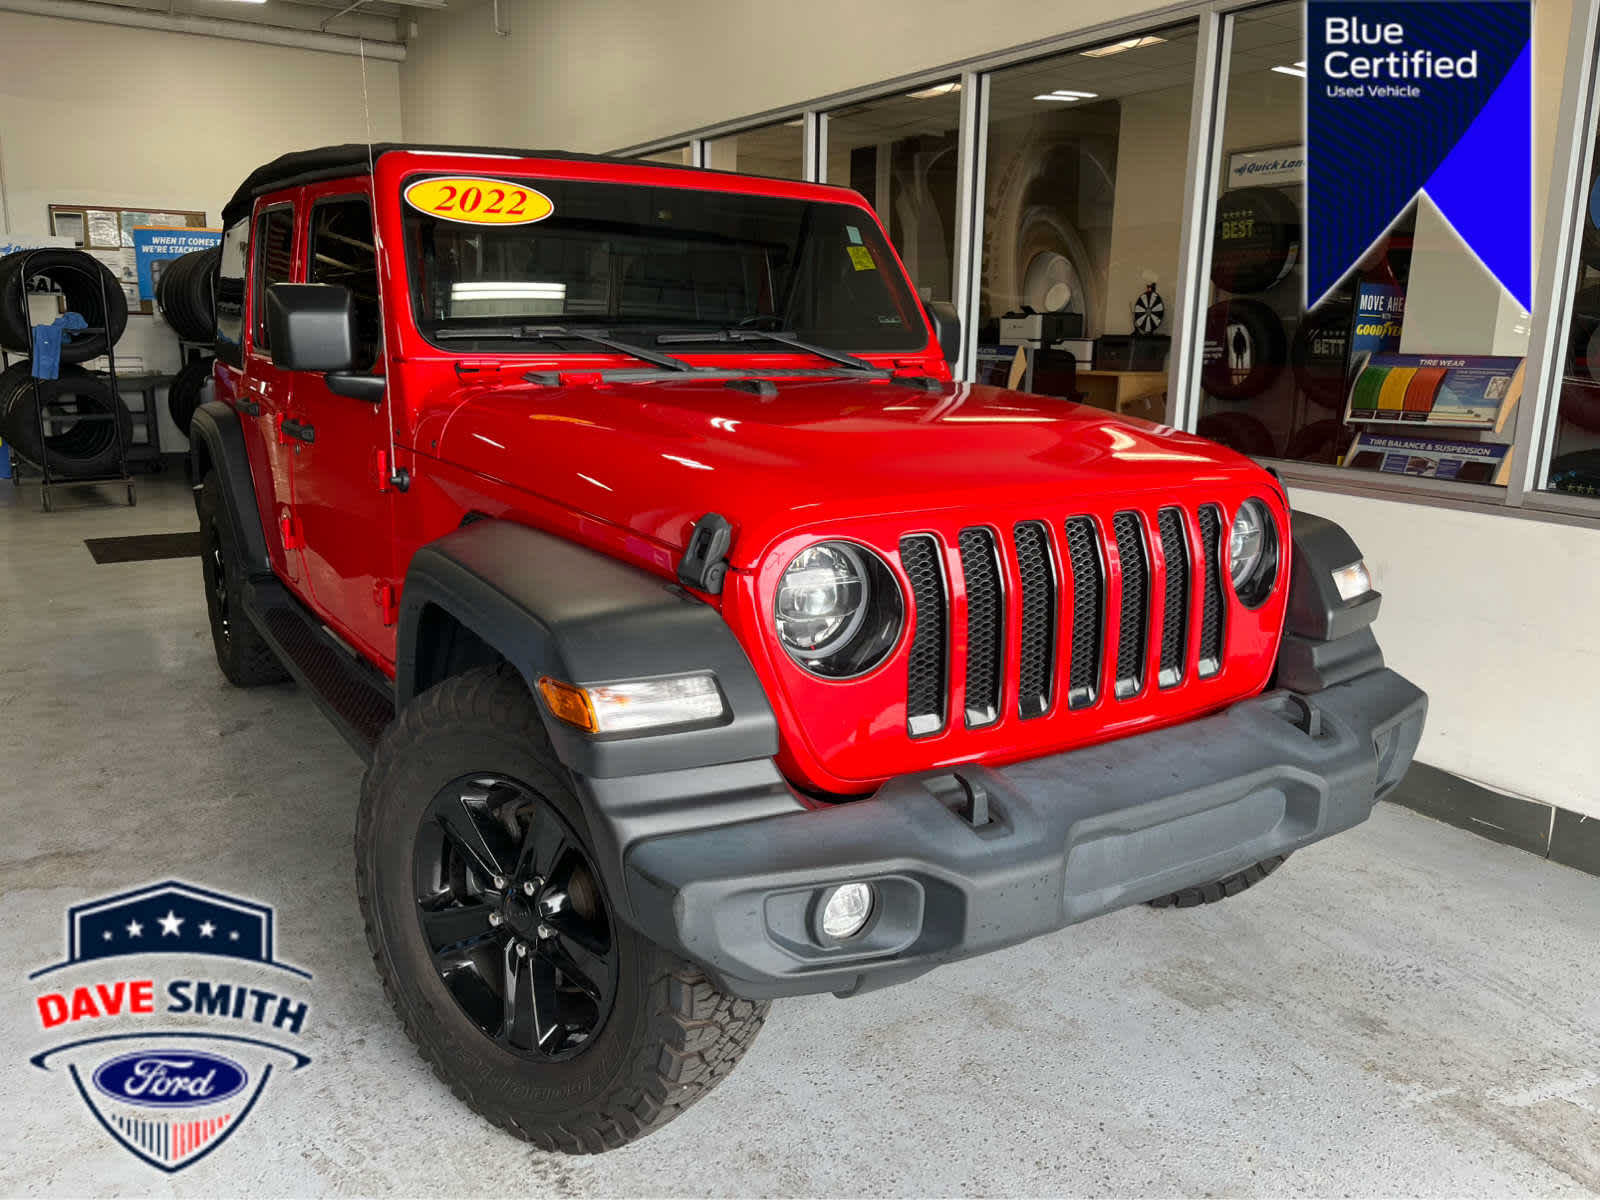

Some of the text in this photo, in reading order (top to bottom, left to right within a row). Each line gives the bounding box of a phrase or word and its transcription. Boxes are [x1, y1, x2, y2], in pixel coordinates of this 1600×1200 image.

[1247, 160, 1278, 173] Quick
[434, 185, 528, 215] 2022
[1222, 220, 1254, 240] BEST
[152, 236, 177, 245] WHEN
[178, 237, 186, 245] IT
[188, 237, 216, 246] COMES
[141, 245, 168, 254] WE'RE
[1359, 294, 1384, 311] MOVE
[1419, 359, 1466, 368] TIRE WEAR
[1369, 438, 1492, 456] TIRE BALANCE & SUSPENSION
